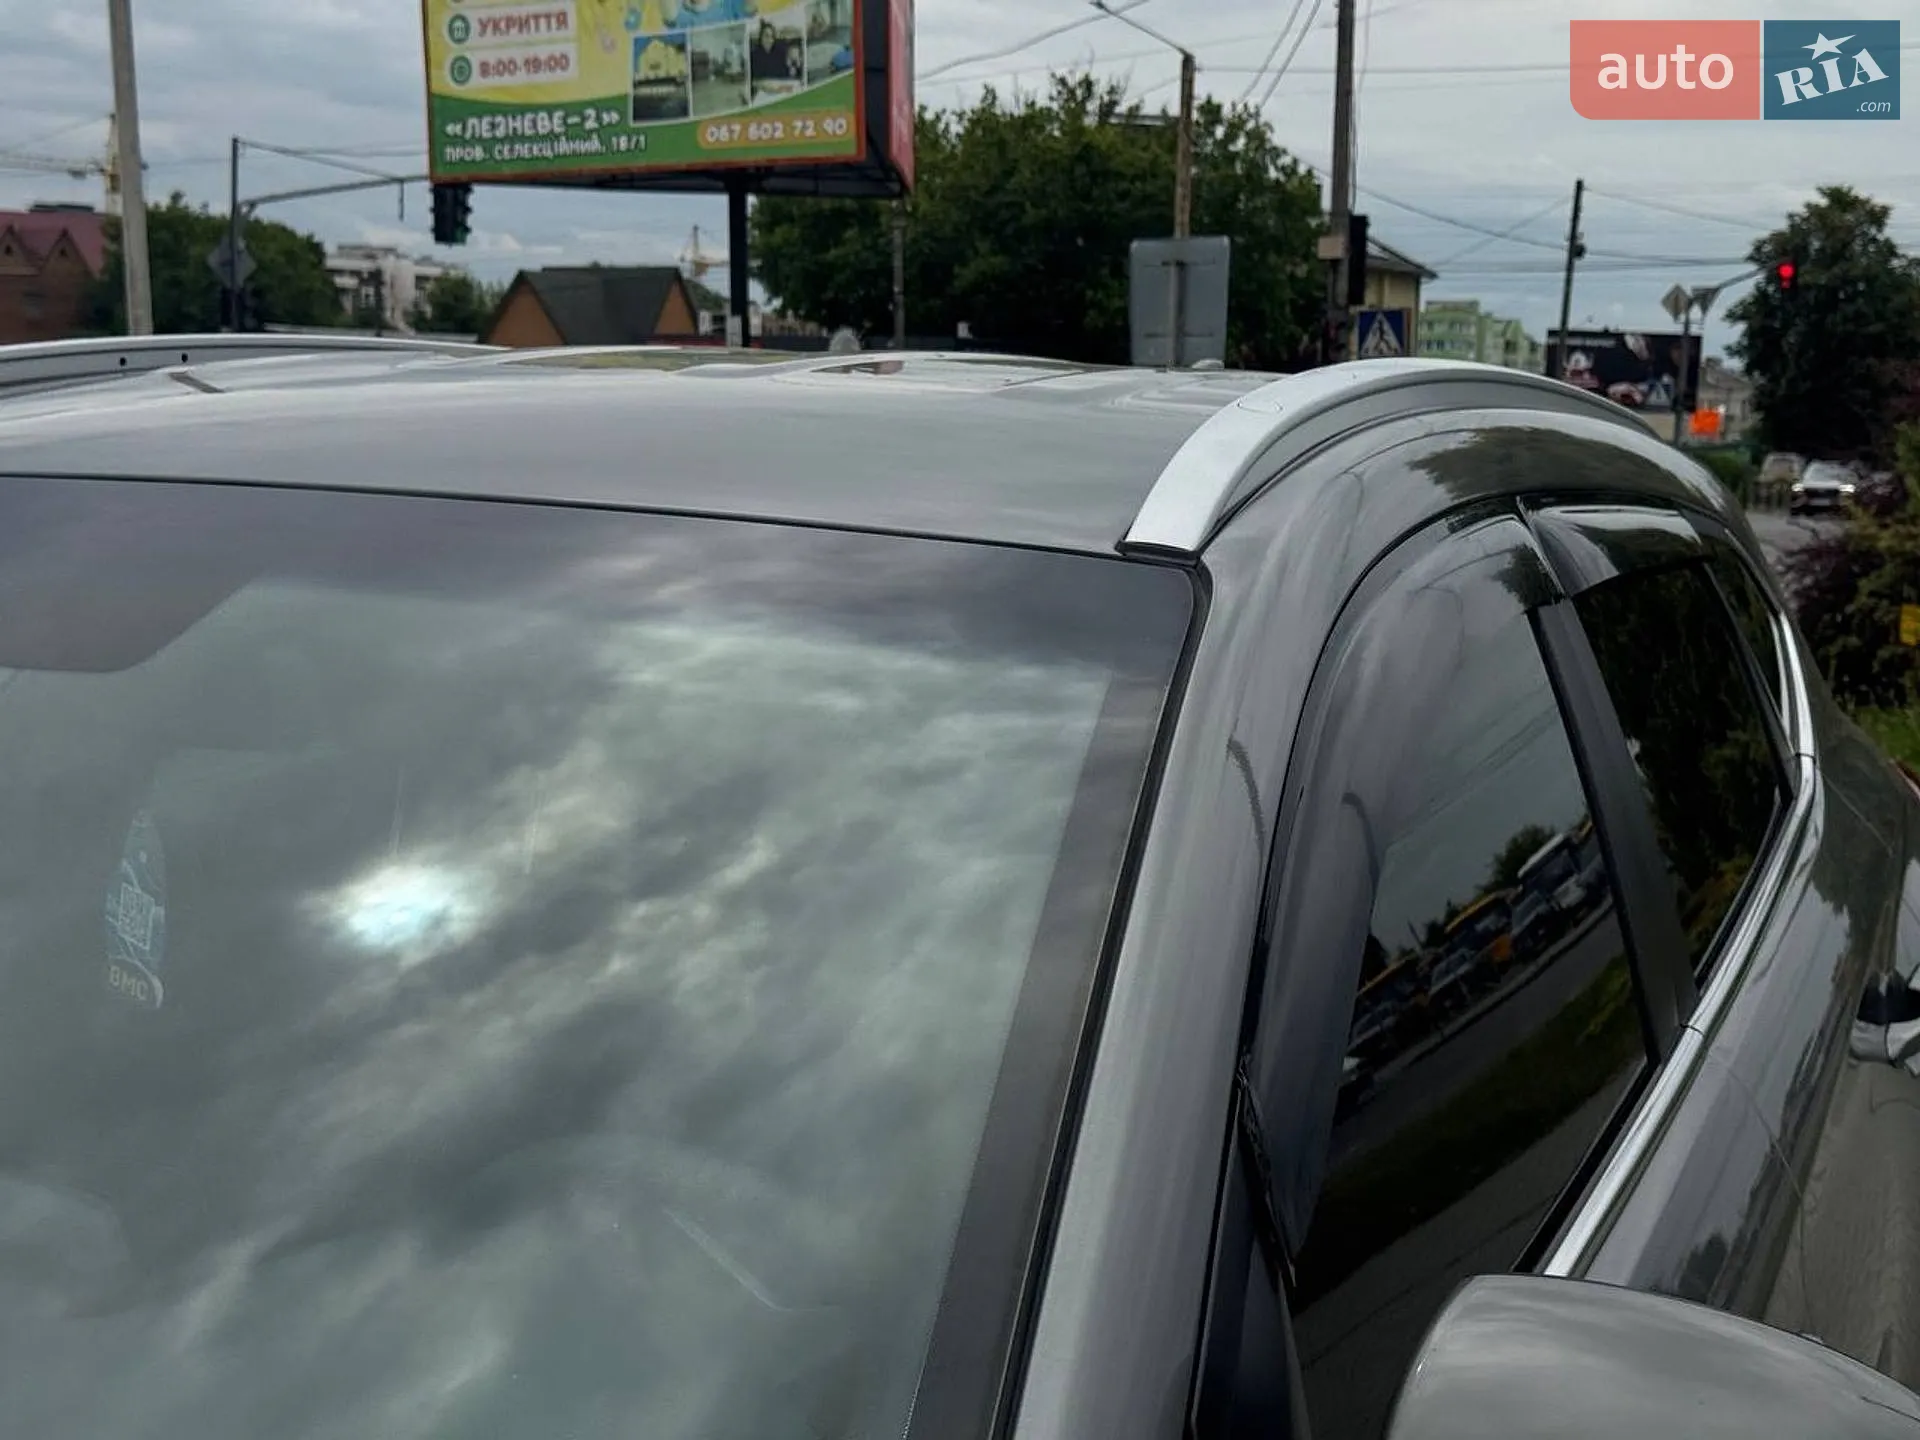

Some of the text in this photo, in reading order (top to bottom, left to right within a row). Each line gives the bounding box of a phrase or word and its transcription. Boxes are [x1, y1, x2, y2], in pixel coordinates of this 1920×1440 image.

[478, 11, 569, 37] УКРИТТЯ
[478, 52, 570, 79] 8:00-19:00
[611, 133, 646, 152] 18/1
[705, 117, 848, 143] 067 602 72 90
